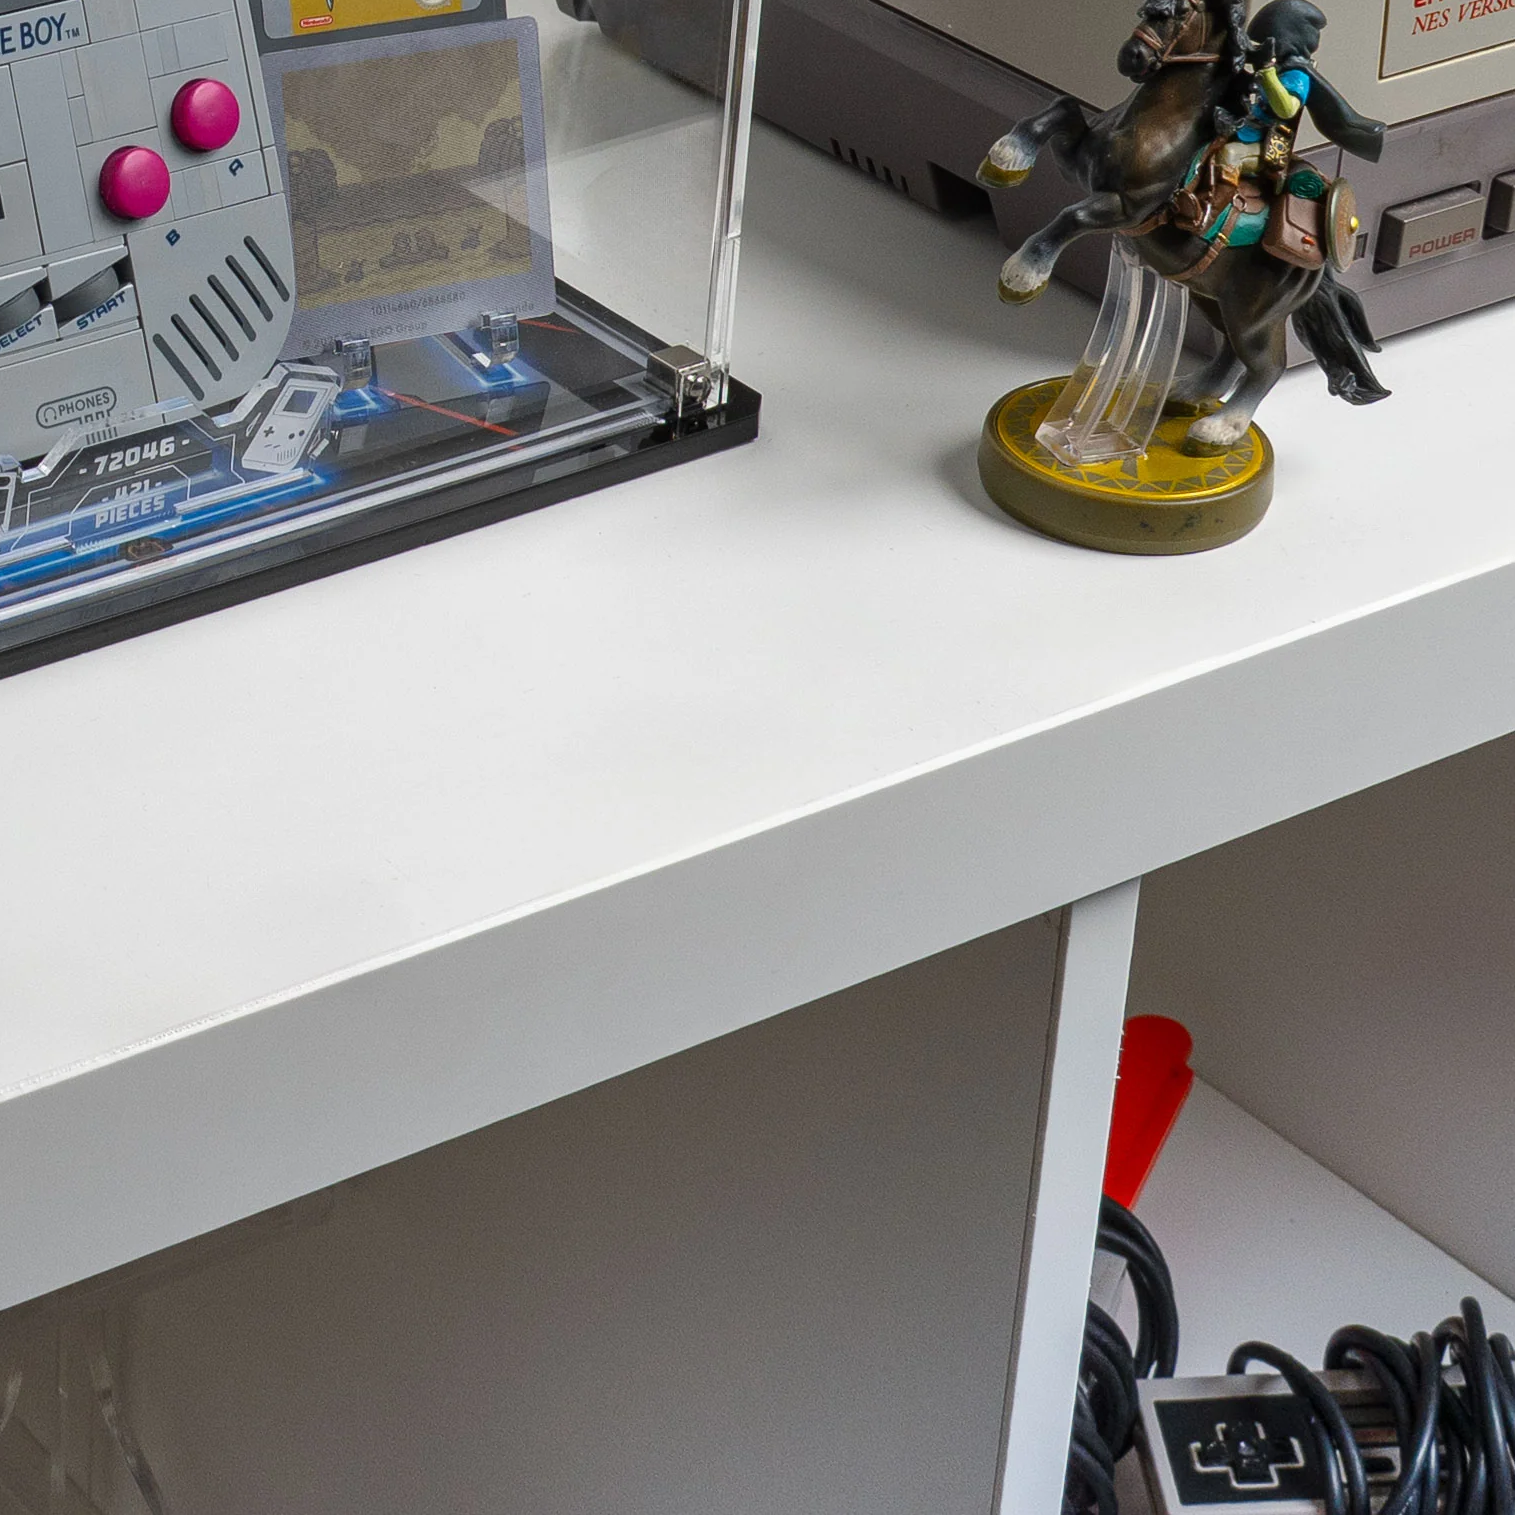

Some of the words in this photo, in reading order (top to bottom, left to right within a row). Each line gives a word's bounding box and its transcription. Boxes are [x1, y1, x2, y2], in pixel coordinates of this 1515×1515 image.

[1411, 8, 1451, 36] NES
[228, 158, 244, 177] A
[165, 228, 181, 247] B
[1408, 227, 1476, 259] POWER
[76, 290, 126, 331] START
[58, 391, 110, 417] PHONES
[93, 435, 176, 476] 72046
[94, 494, 165, 529] PIECES
